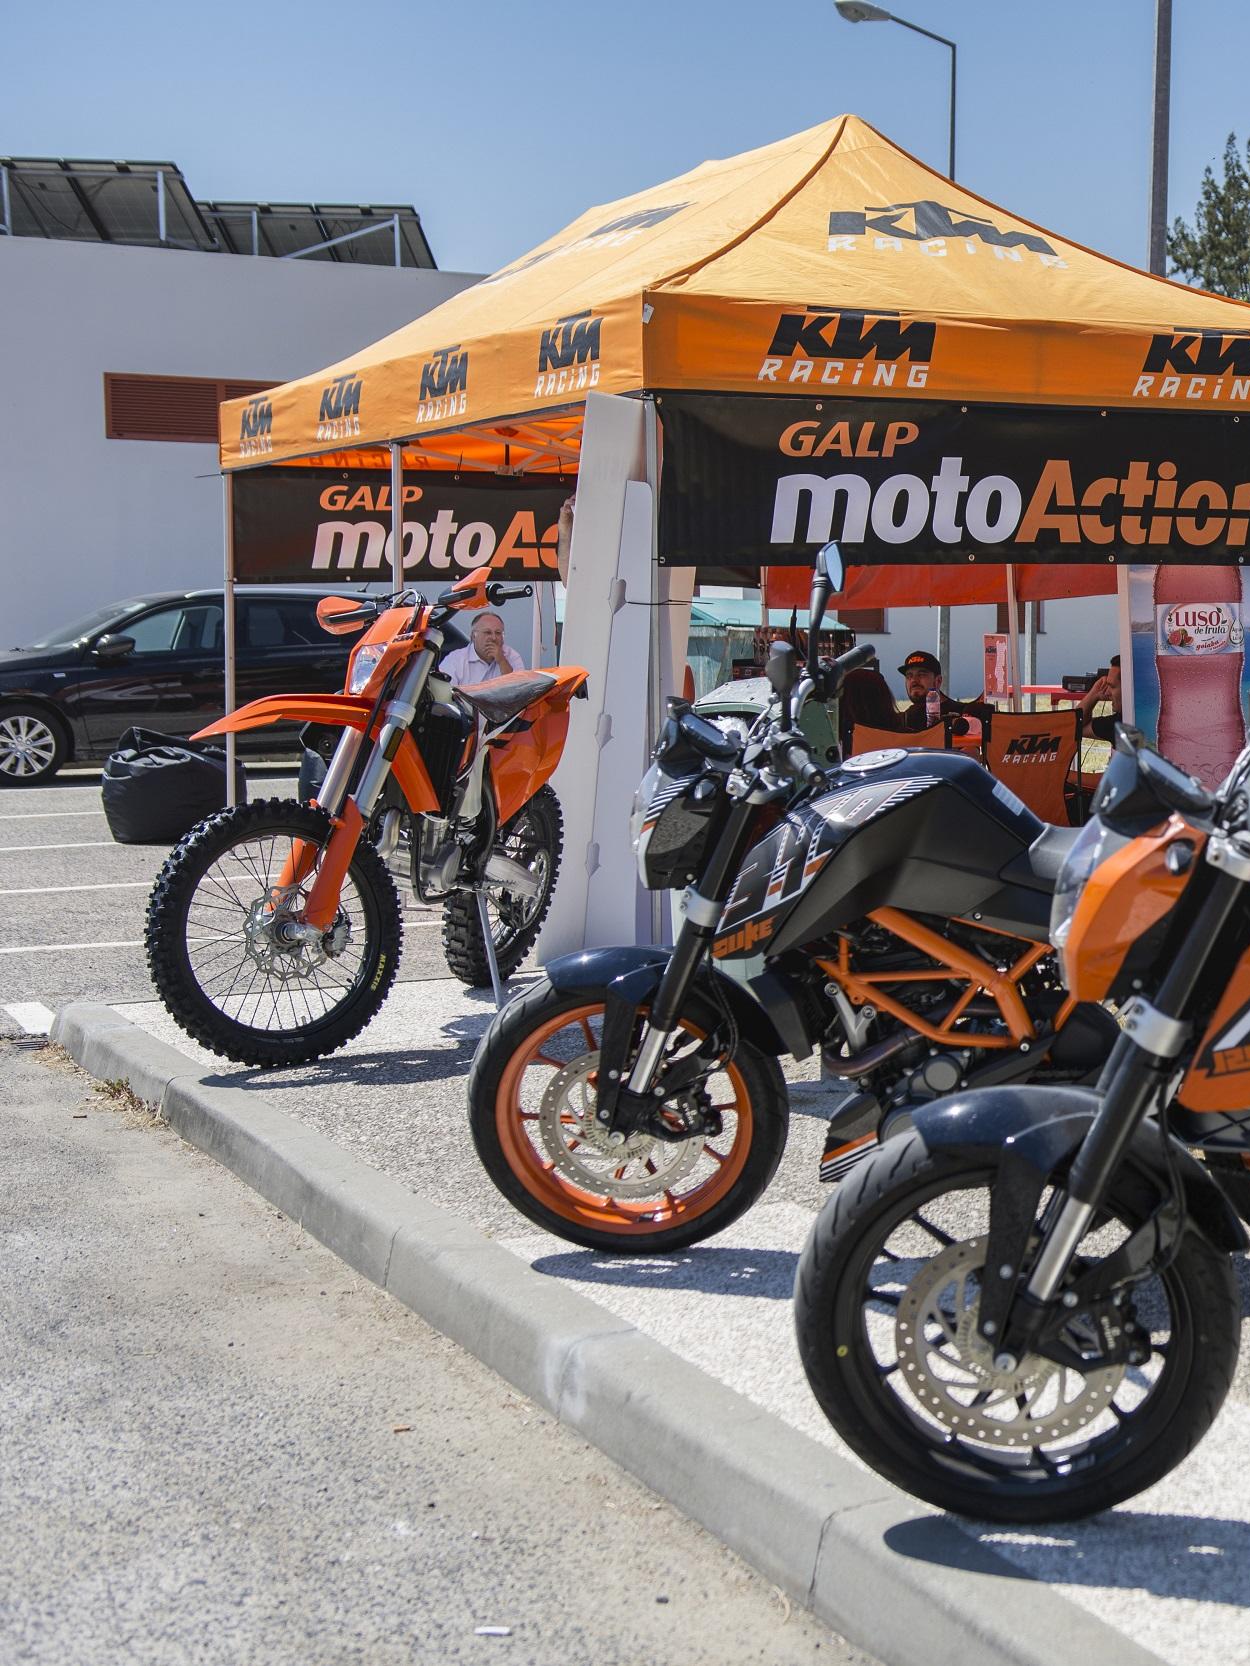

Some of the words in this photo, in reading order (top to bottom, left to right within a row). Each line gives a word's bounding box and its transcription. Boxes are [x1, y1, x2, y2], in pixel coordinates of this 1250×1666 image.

[829, 201, 1058, 256] KTM
[538, 309, 603, 372] KTM
[767, 306, 936, 362] KTM
[418, 344, 468, 400] KTM
[240, 396, 272, 440] KTM
[319, 373, 363, 422] KTM
[778, 420, 920, 457] GALP
[319, 485, 423, 511] GALP
[1175, 610, 1221, 627] LUSO
[1204, 625, 1226, 635] fruta
[1006, 733, 1062, 755] KTM
[370, 953, 387, 992] MAXXIS
